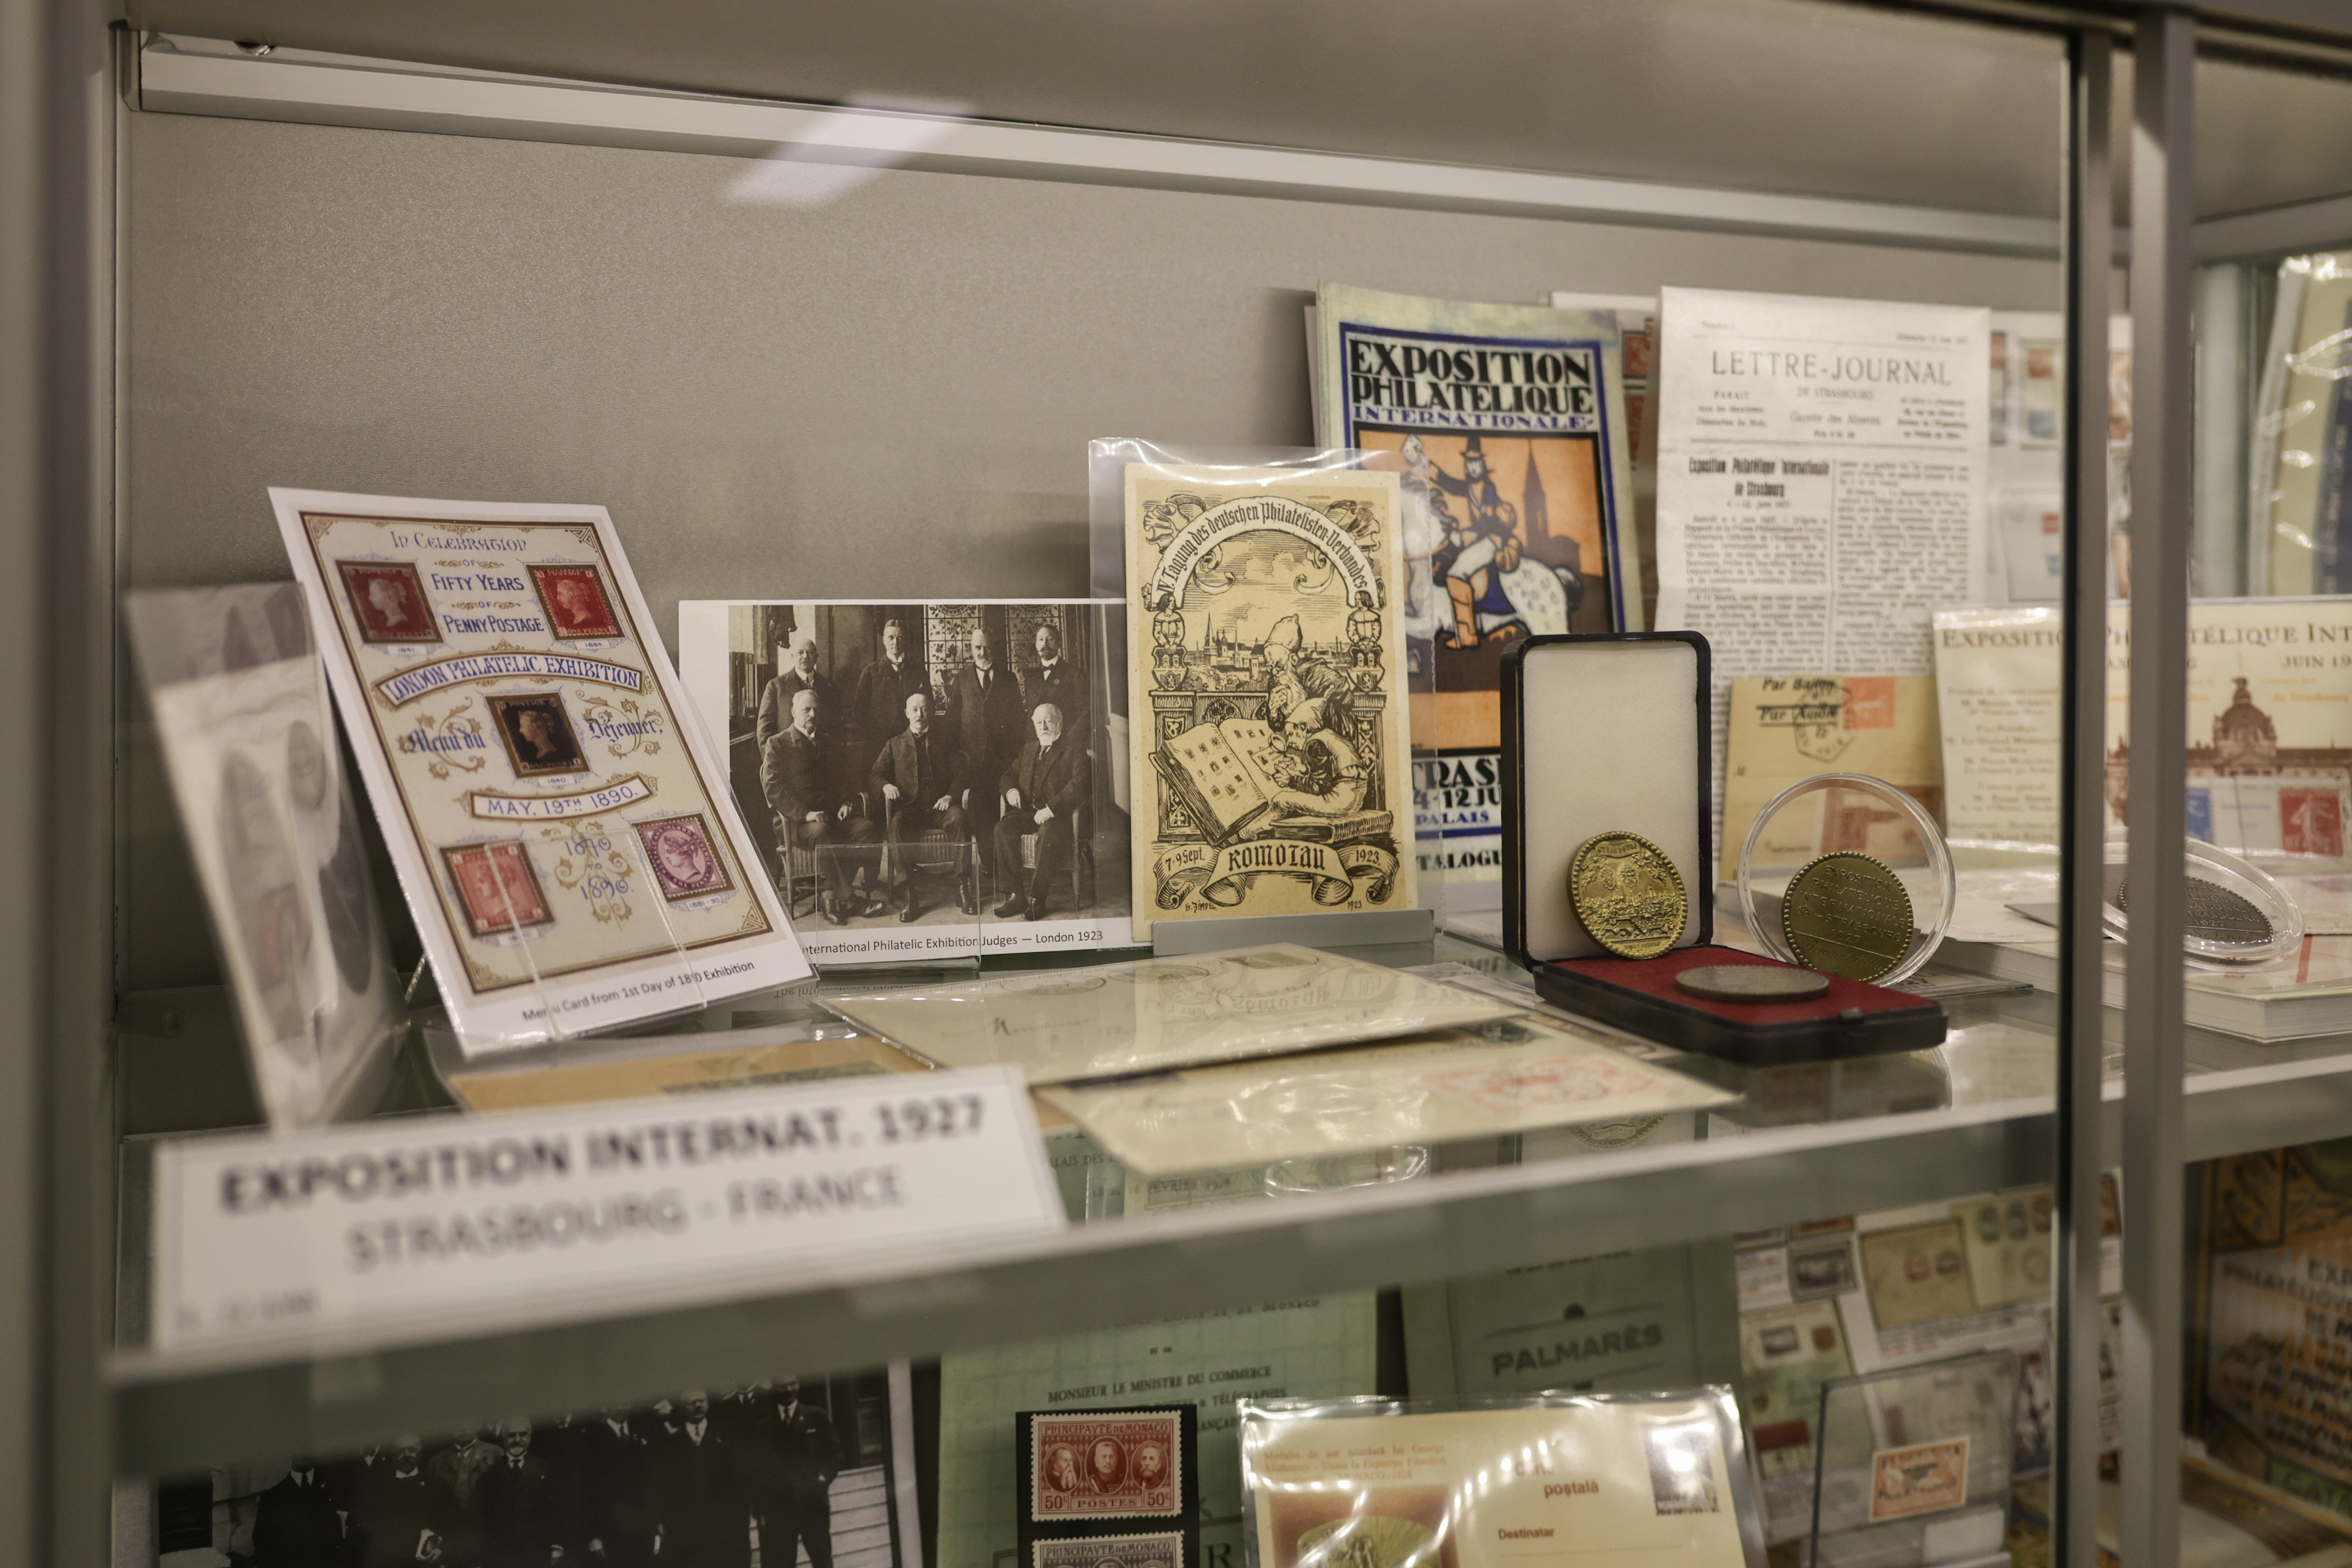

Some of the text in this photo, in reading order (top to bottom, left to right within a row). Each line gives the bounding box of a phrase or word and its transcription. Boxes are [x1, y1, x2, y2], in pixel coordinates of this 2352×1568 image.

[1349, 339, 1591, 385] EXPOSITION
[1712, 350, 1951, 386] LETTRE-JOURNAL
[1351, 373, 1594, 415] PHILATELIQUE
[1161, 539, 1198, 583] Tagung
[1187, 525, 1210, 546] des
[1205, 505, 1260, 534] deutschen
[462, 559, 476, 567] OF
[431, 573, 525, 591] FIFTY YEARS
[478, 601, 492, 609] OF
[442, 615, 545, 633] PENNY POSTAGE
[2282, 655, 2325, 669] JUIN
[384, 656, 639, 701] LONDON PHILATELIC EXHIBITION
[1416, 810, 1490, 826] PALAIS
[1824, 864, 1893, 891] EXPOSITION
[1347, 900, 1363, 911] 1923
[1811, 877, 1900, 911] PHILATELIQUE
[1797, 890, 1907, 929] INTERNATIONALE
[1825, 913, 1902, 942] STRASBOURG
[801, 941, 870, 954] nternational
[872, 938, 923, 952] Philatelic
[925, 937, 979, 950] Exhibition
[982, 936, 1018, 949] Judges
[1035, 932, 1075, 944] London
[1077, 930, 1104, 943] 1923
[562, 993, 590, 1014] Card
[590, 989, 620, 1004] from
[622, 985, 639, 999] 1st
[641, 982, 663, 994] Day
[664, 974, 675, 989] of
[703, 960, 755, 982] Exhibition
[219, 1093, 986, 1217] EXPOSITION INTERNAT. 1927
[1047, 1154, 1080, 1168] ALAIS
[344, 1192, 688, 1273] STRASBOURG
[726, 1161, 907, 1225] FRANCE
[1048, 1365, 1271, 1403] MONSIEUR LE MINISTRE DU COMMERCE
[1078, 1497, 1137, 1508] POSTES
[1497, 1527, 1555, 1542] Destinatar
